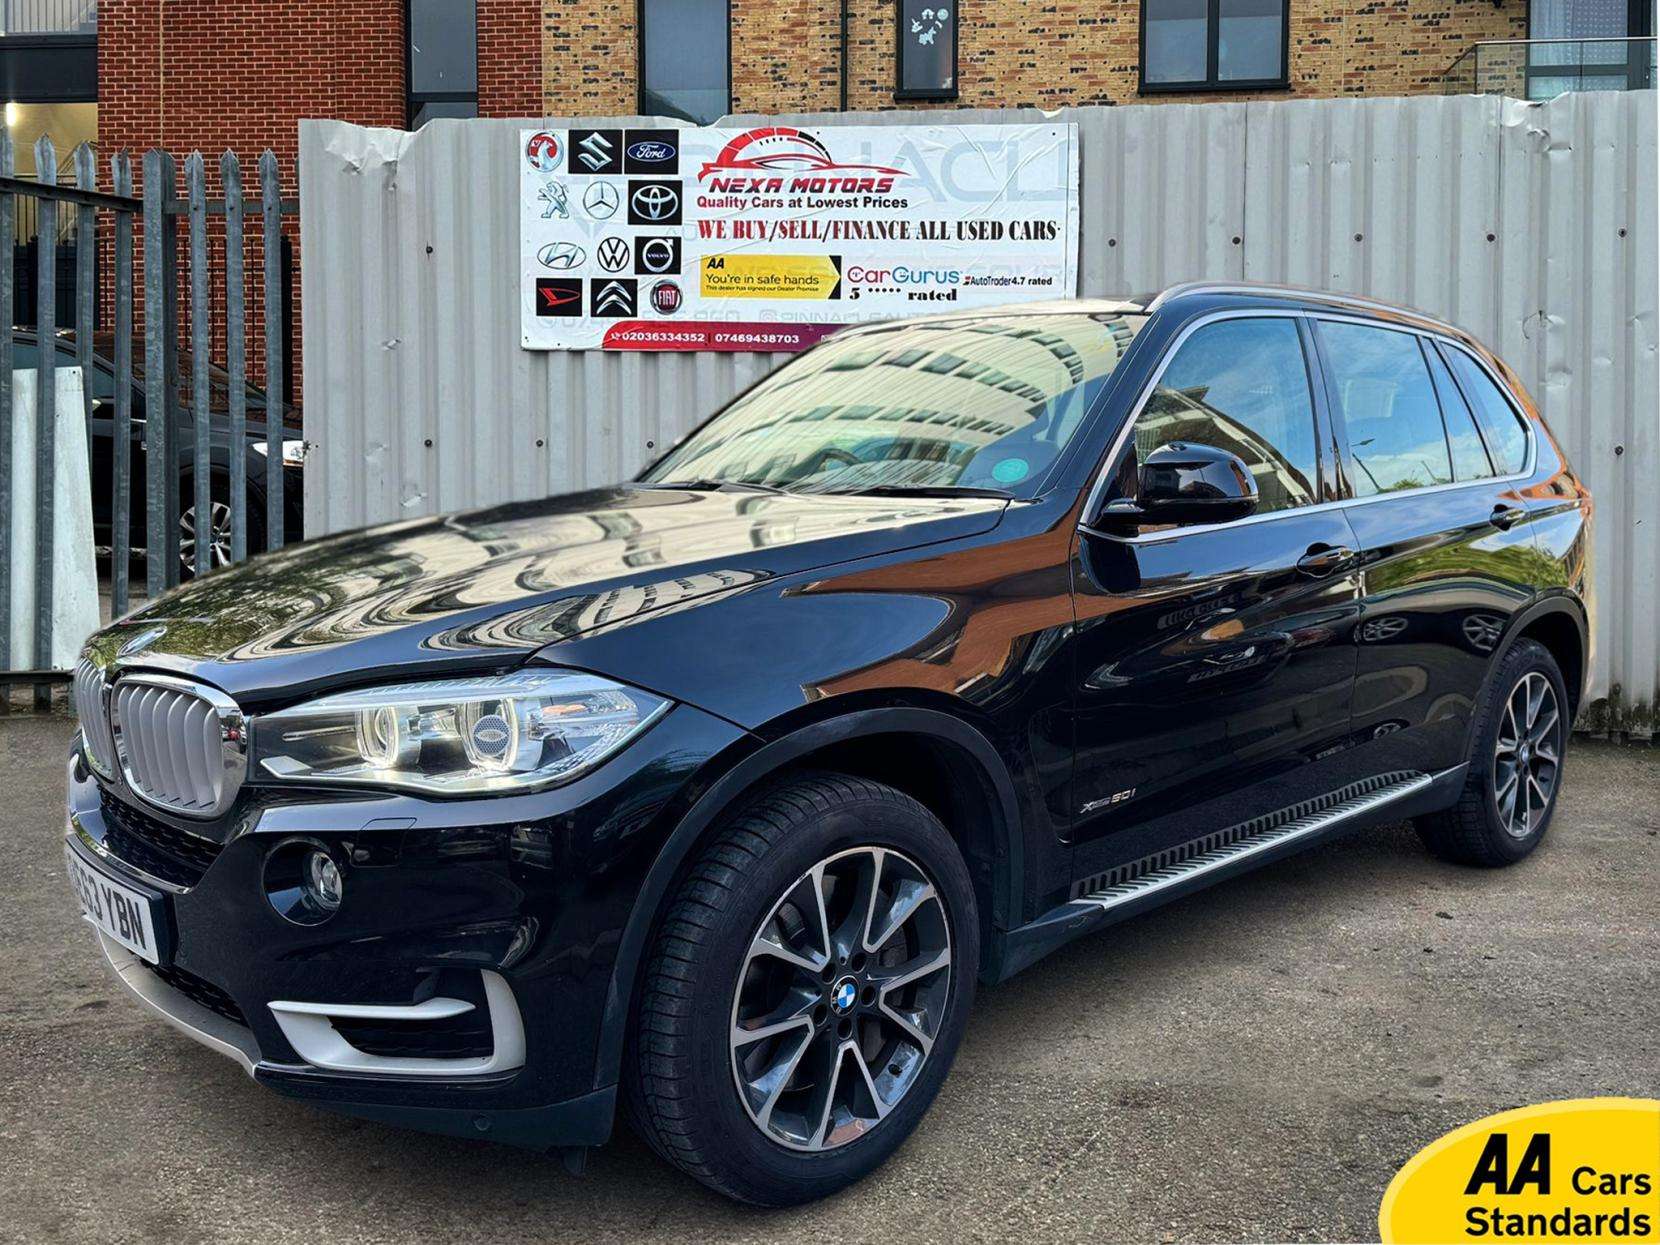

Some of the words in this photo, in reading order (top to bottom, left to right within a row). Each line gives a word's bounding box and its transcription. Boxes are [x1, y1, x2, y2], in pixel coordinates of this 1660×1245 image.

[636, 143, 667, 159] Ford
[708, 177, 784, 194] NEXA
[789, 177, 894, 194] MOTORS
[697, 195, 748, 211] Quality
[751, 196, 784, 208] Cars
[788, 196, 803, 208] at
[807, 196, 859, 208] Lowest
[863, 195, 908, 208] Prices
[697, 219, 727, 240] WE
[915, 220, 951, 241] ALL
[956, 220, 1004, 241] USED
[706, 257, 725, 270] AA
[706, 273, 743, 285] You're
[744, 273, 755, 285] in
[757, 273, 781, 286] safe
[784, 274, 820, 286] hands
[847, 266, 960, 284] CarGurus
[1028, 276, 1053, 286] rated
[658, 290, 676, 306] FIAT
[849, 287, 860, 300] 5
[908, 288, 957, 301] rated
[622, 333, 705, 343] 02036334352
[715, 333, 800, 344] 07469438703
[101, 883, 147, 951] YBN
